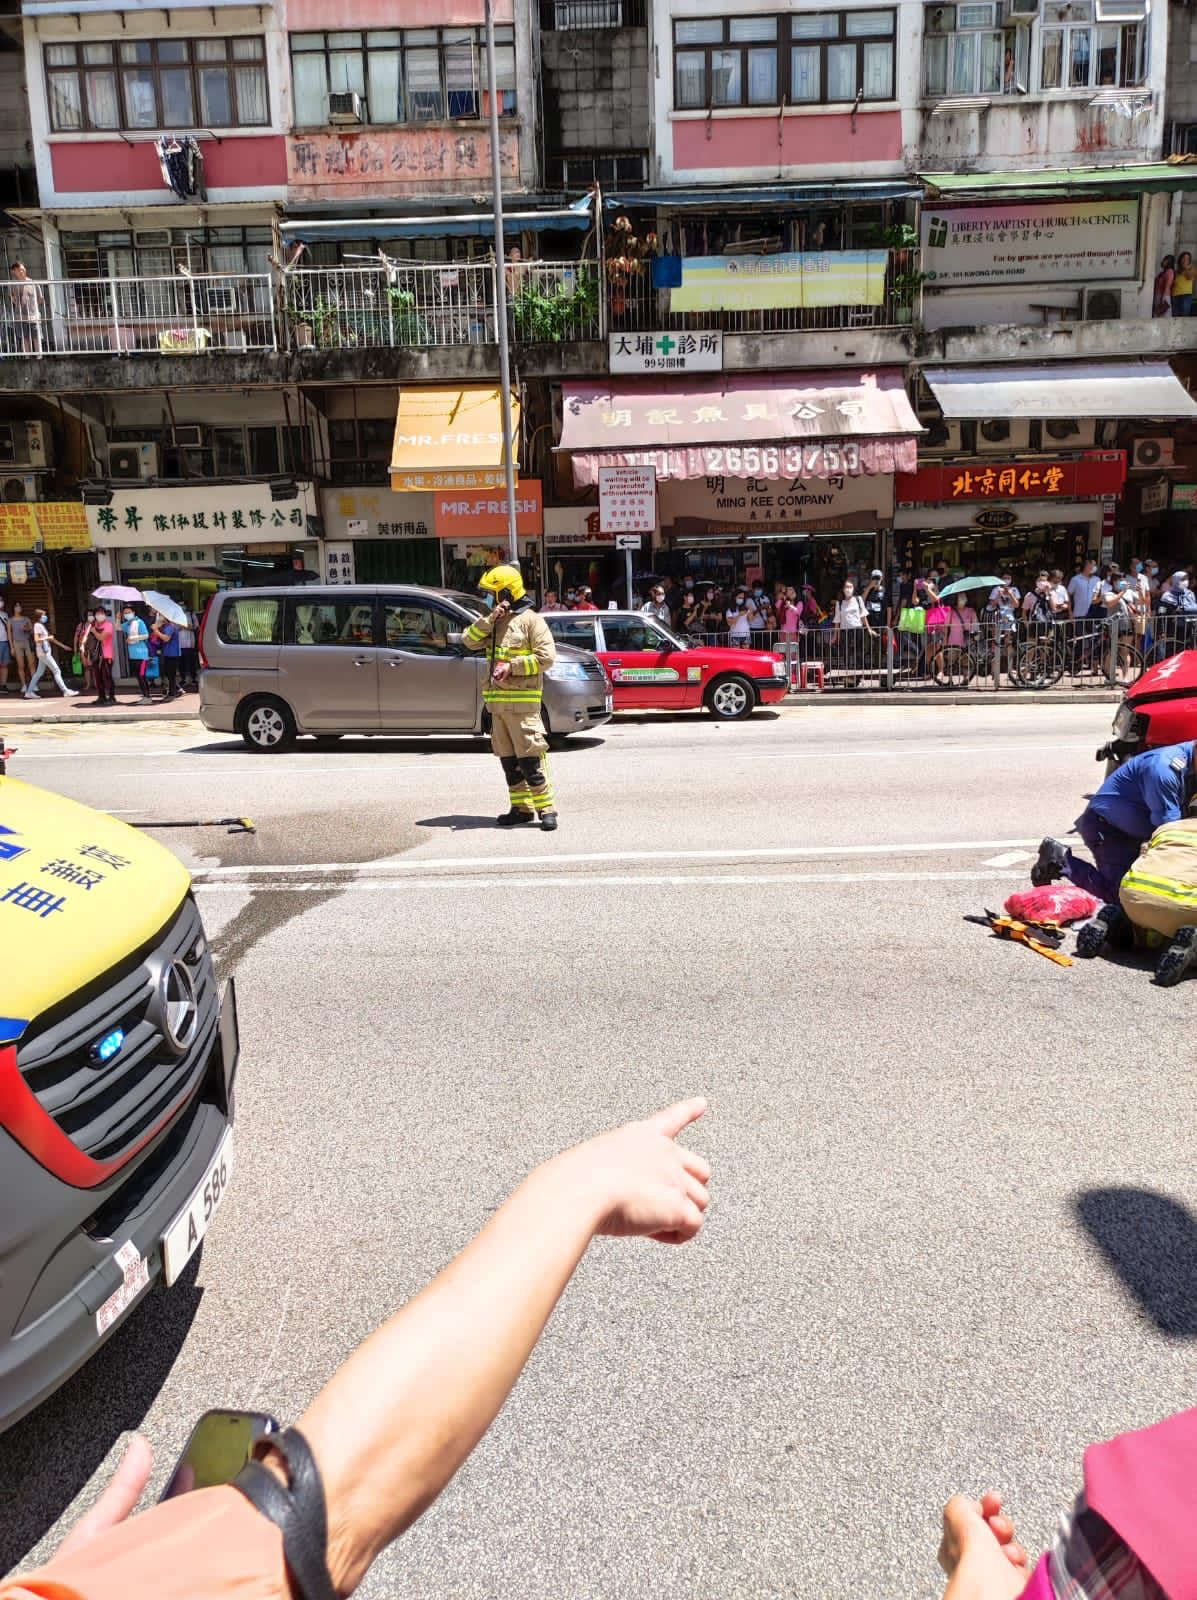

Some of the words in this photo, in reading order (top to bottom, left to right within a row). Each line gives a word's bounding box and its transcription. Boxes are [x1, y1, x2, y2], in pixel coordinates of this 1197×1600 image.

[951, 222, 992, 233] LIBERTY
[993, 219, 1031, 231] BAPTIST
[1032, 217, 1081, 228] CHURCH
[1087, 214, 1131, 225] CENTER
[613, 335, 654, 356] 大埔
[678, 334, 719, 355] 診所
[601, 399, 866, 428] 明記魚具公司
[398, 432, 505, 447] MR.FRES
[952, 466, 1065, 496] 北京同仁堂
[441, 500, 537, 515] MR.FRESH
[717, 496, 746, 509] MING
[750, 495, 774, 507] KEE
[777, 494, 835, 507] COMPANY
[376, 521, 428, 535] 美術用品
[187, 1211, 198, 1253] A
[203, 1156, 228, 1222] 586
